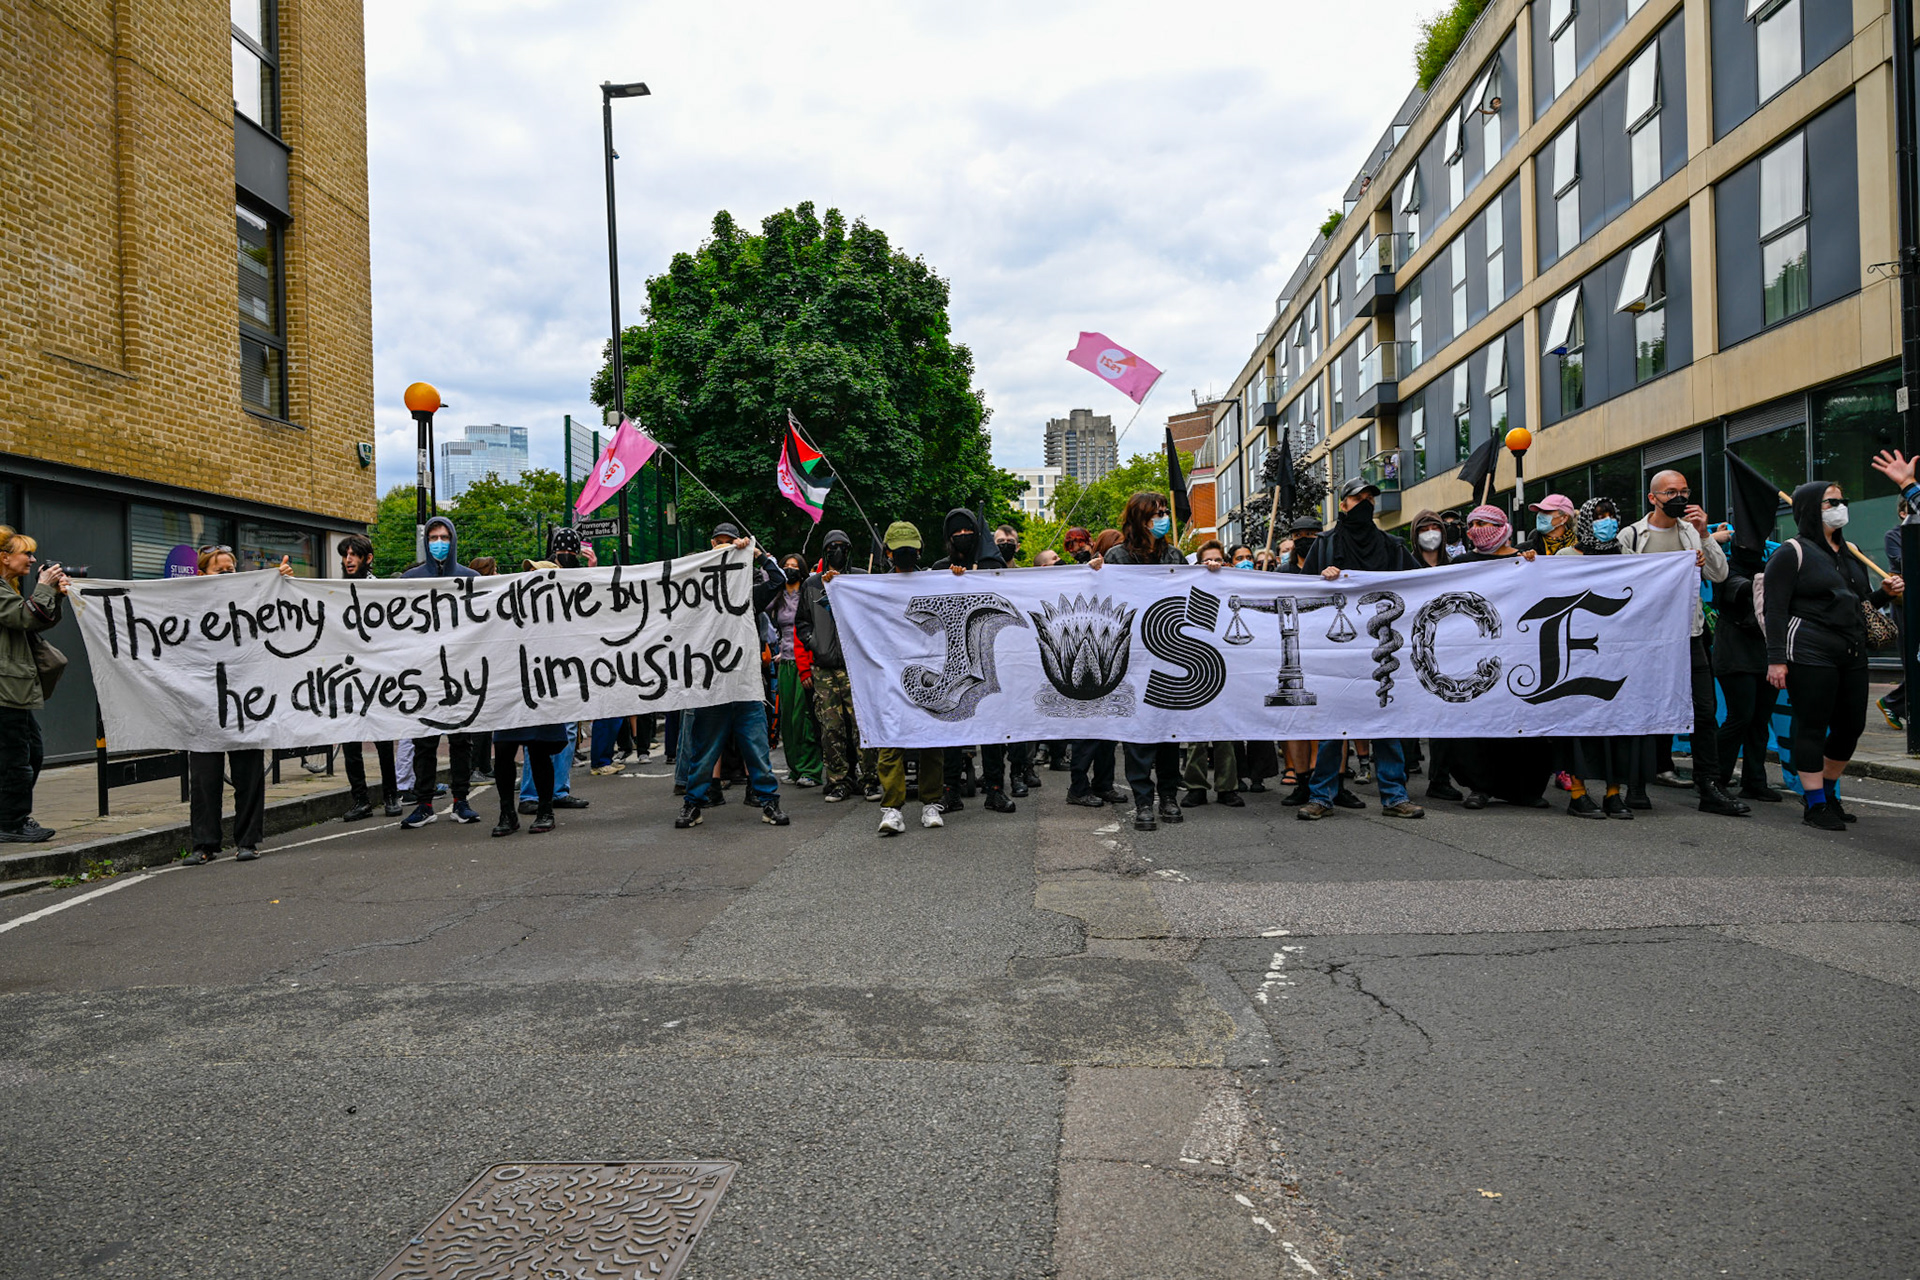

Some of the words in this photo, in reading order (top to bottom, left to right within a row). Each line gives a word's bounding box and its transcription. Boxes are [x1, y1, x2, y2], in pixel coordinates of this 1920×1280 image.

[79, 587, 190, 660] The
[200, 597, 326, 659] enemy
[342, 575, 490, 643] doesn't
[496, 569, 602, 629] arrive
[599, 564, 650, 647] by
[657, 551, 750, 622] boat
[170, 564, 178, 573] ST
[178, 565, 195, 575] LUKE'S
[215, 661, 277, 734] he
[291, 654, 428, 720] arrives
[417, 644, 489, 731] by
[518, 635, 743, 710] limousine
[901, 586, 1634, 721] JUSTICE
